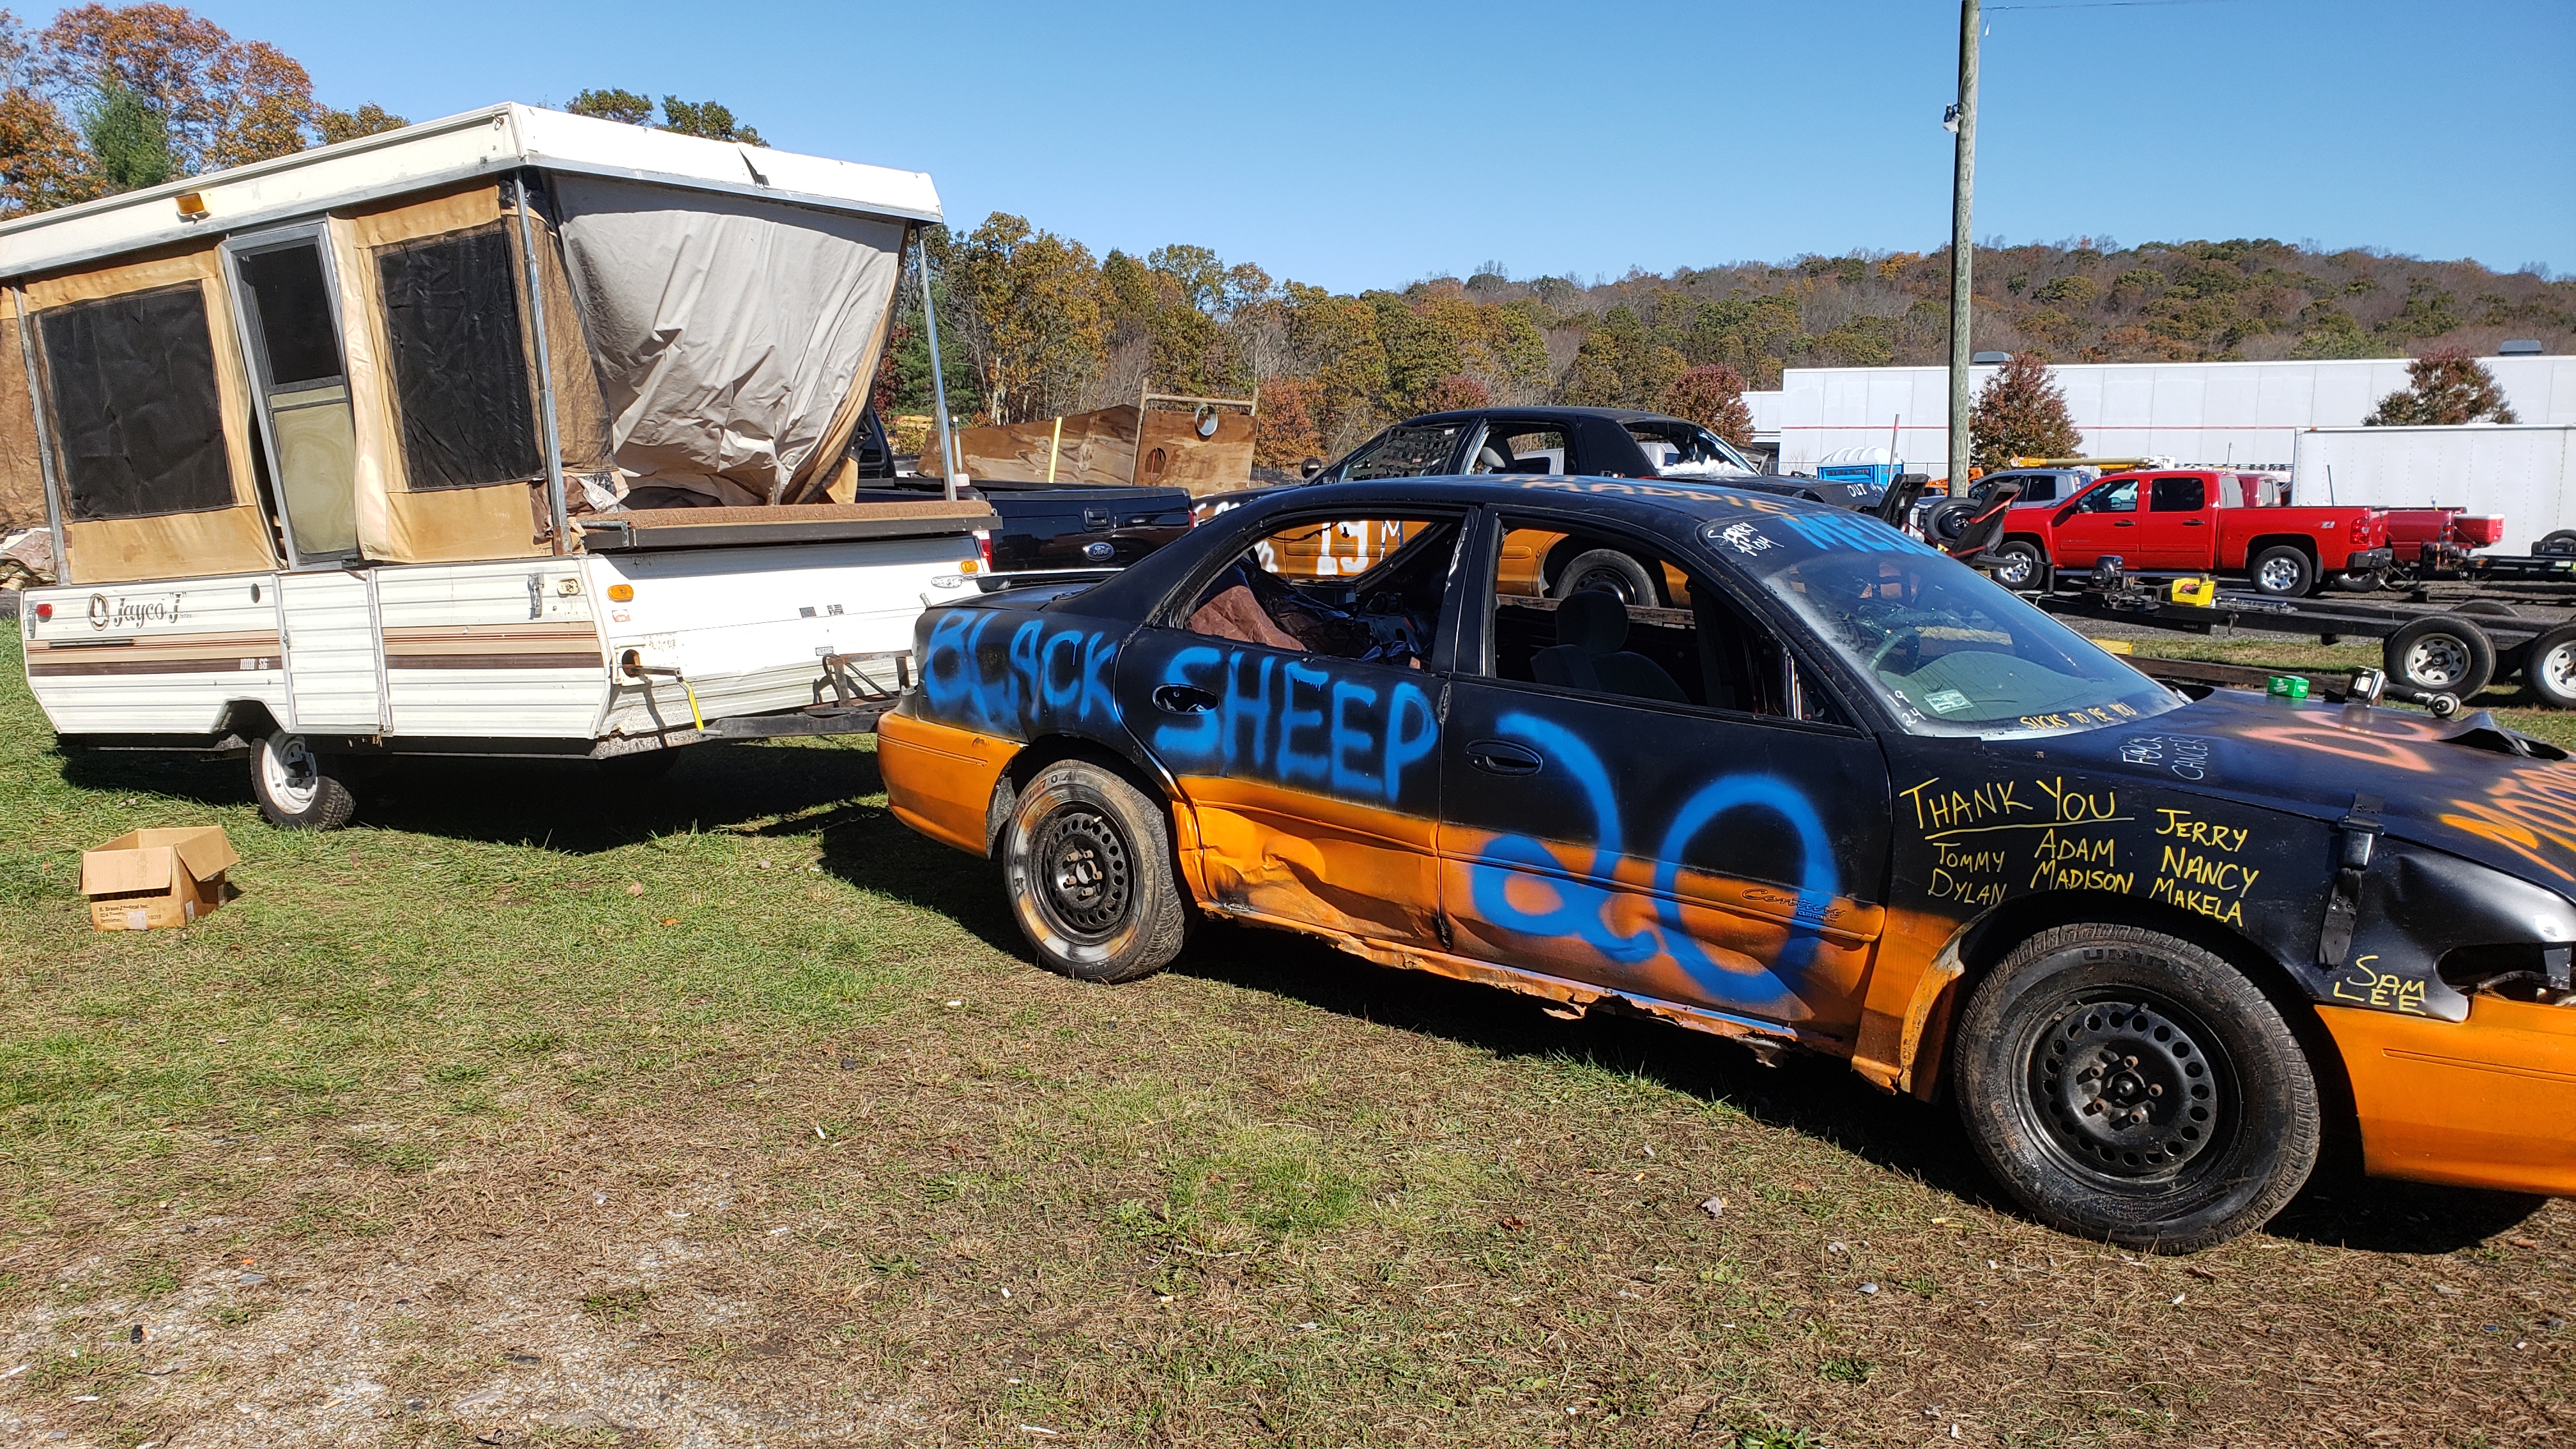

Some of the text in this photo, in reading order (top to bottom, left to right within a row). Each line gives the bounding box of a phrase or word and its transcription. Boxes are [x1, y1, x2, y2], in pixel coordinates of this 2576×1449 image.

[1093, 546, 1110, 555] Ford
[113, 597, 165, 629] Jayco
[239, 658, 268, 670] 1008 SG
[924, 611, 1124, 733] BLACK
[1154, 646, 1439, 802] SHEEP
[1901, 707, 1927, 727] 24
[2020, 714, 2069, 730] SUCKS
[2068, 712, 2090, 724] TO
[2108, 702, 2137, 718] YOU
[2169, 737, 2208, 780] CANCER
[1899, 776, 2116, 829] THANK YOU
[2034, 829, 2115, 867] ADAM
[2156, 808, 2248, 852] JERRY
[1471, 710, 1840, 1004] 20
[1933, 842, 2005, 873] TOMMY
[2160, 845, 2260, 898] NANCY
[1928, 869, 2007, 905] DYLAN
[2030, 859, 2135, 894] MADISON
[1742, 889, 1846, 918] Century
[2149, 878, 2244, 928] MAKELA
[2346, 955, 2426, 1003] SAM
[2333, 981, 2426, 1016] LEE
